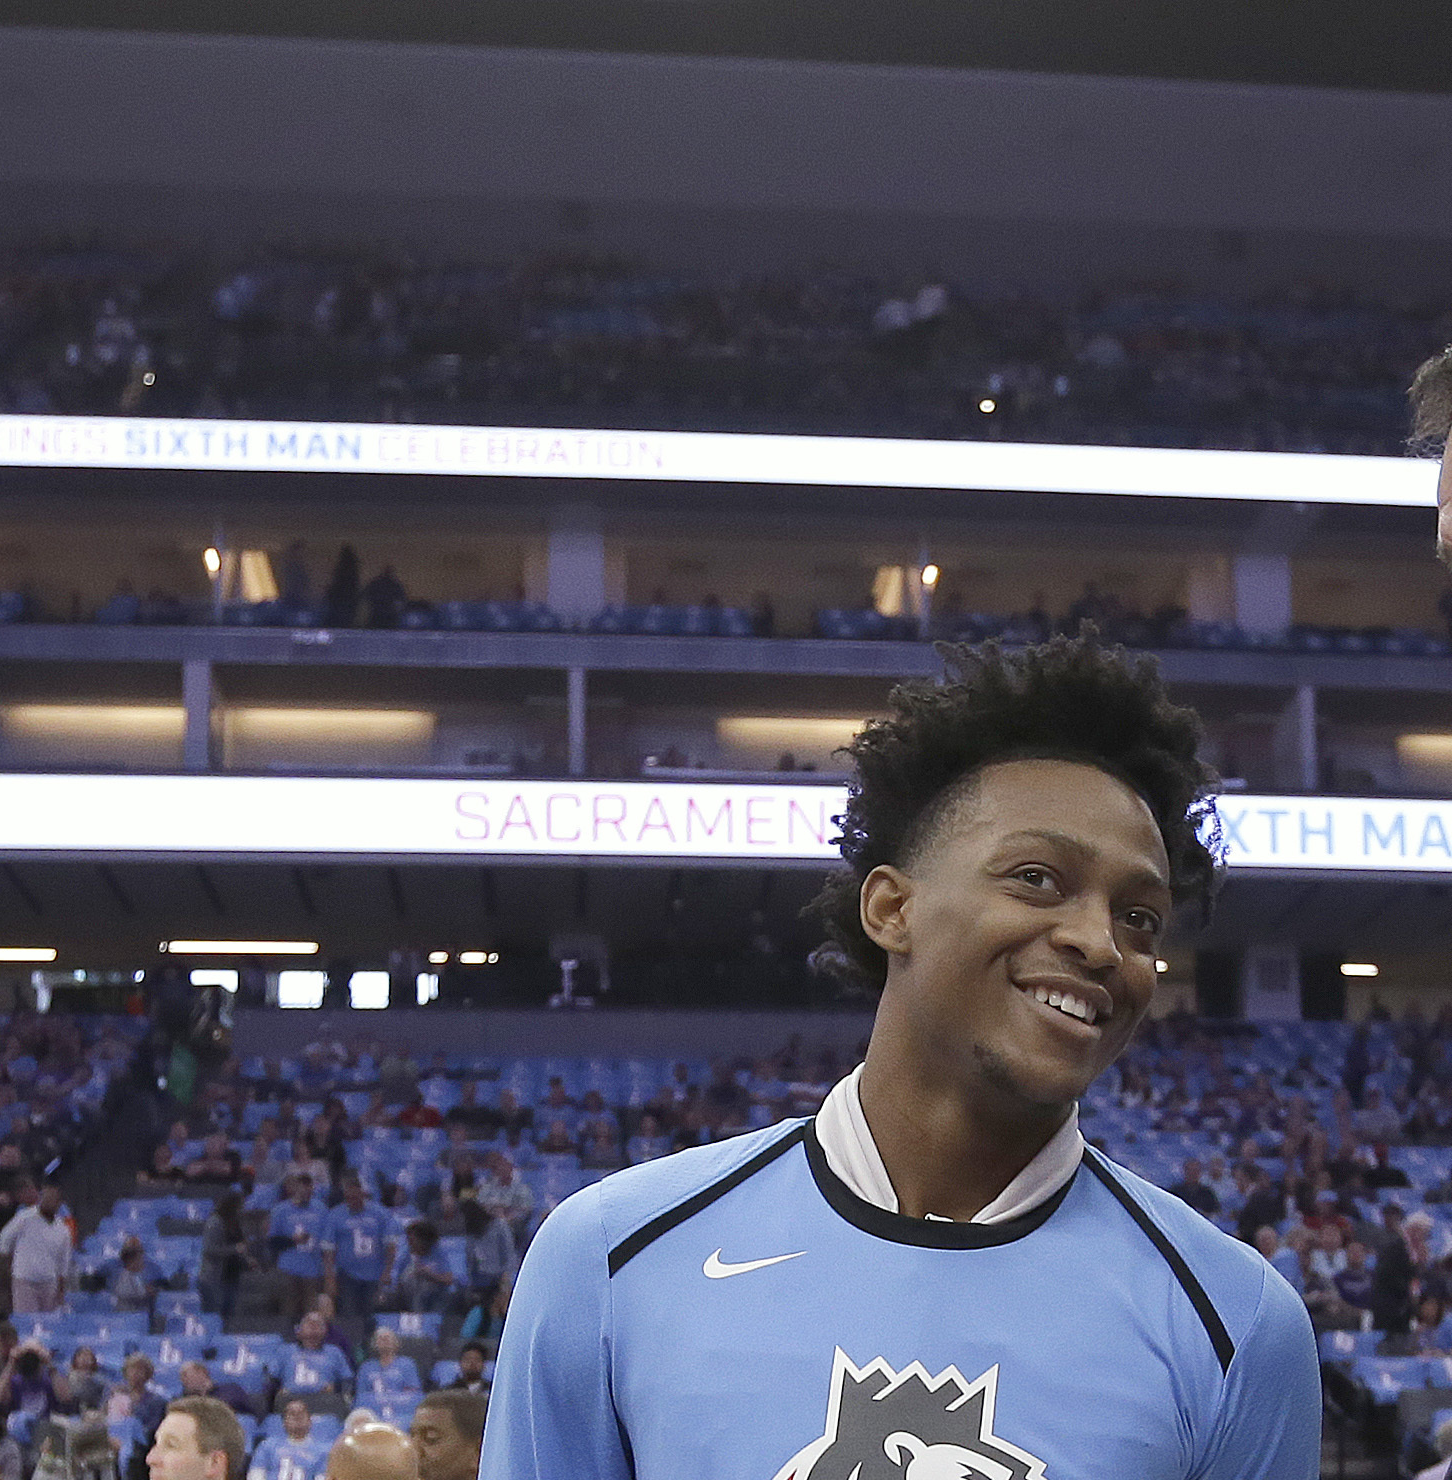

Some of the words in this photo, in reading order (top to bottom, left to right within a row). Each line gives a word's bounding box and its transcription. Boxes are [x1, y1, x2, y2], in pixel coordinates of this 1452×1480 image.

[123, 426, 250, 459] SIXTH
[266, 430, 363, 462] MAN
[377, 431, 665, 470] CELEBRATION
[454, 791, 838, 845] SACRAMEN
[1216, 808, 1335, 856] XTH
